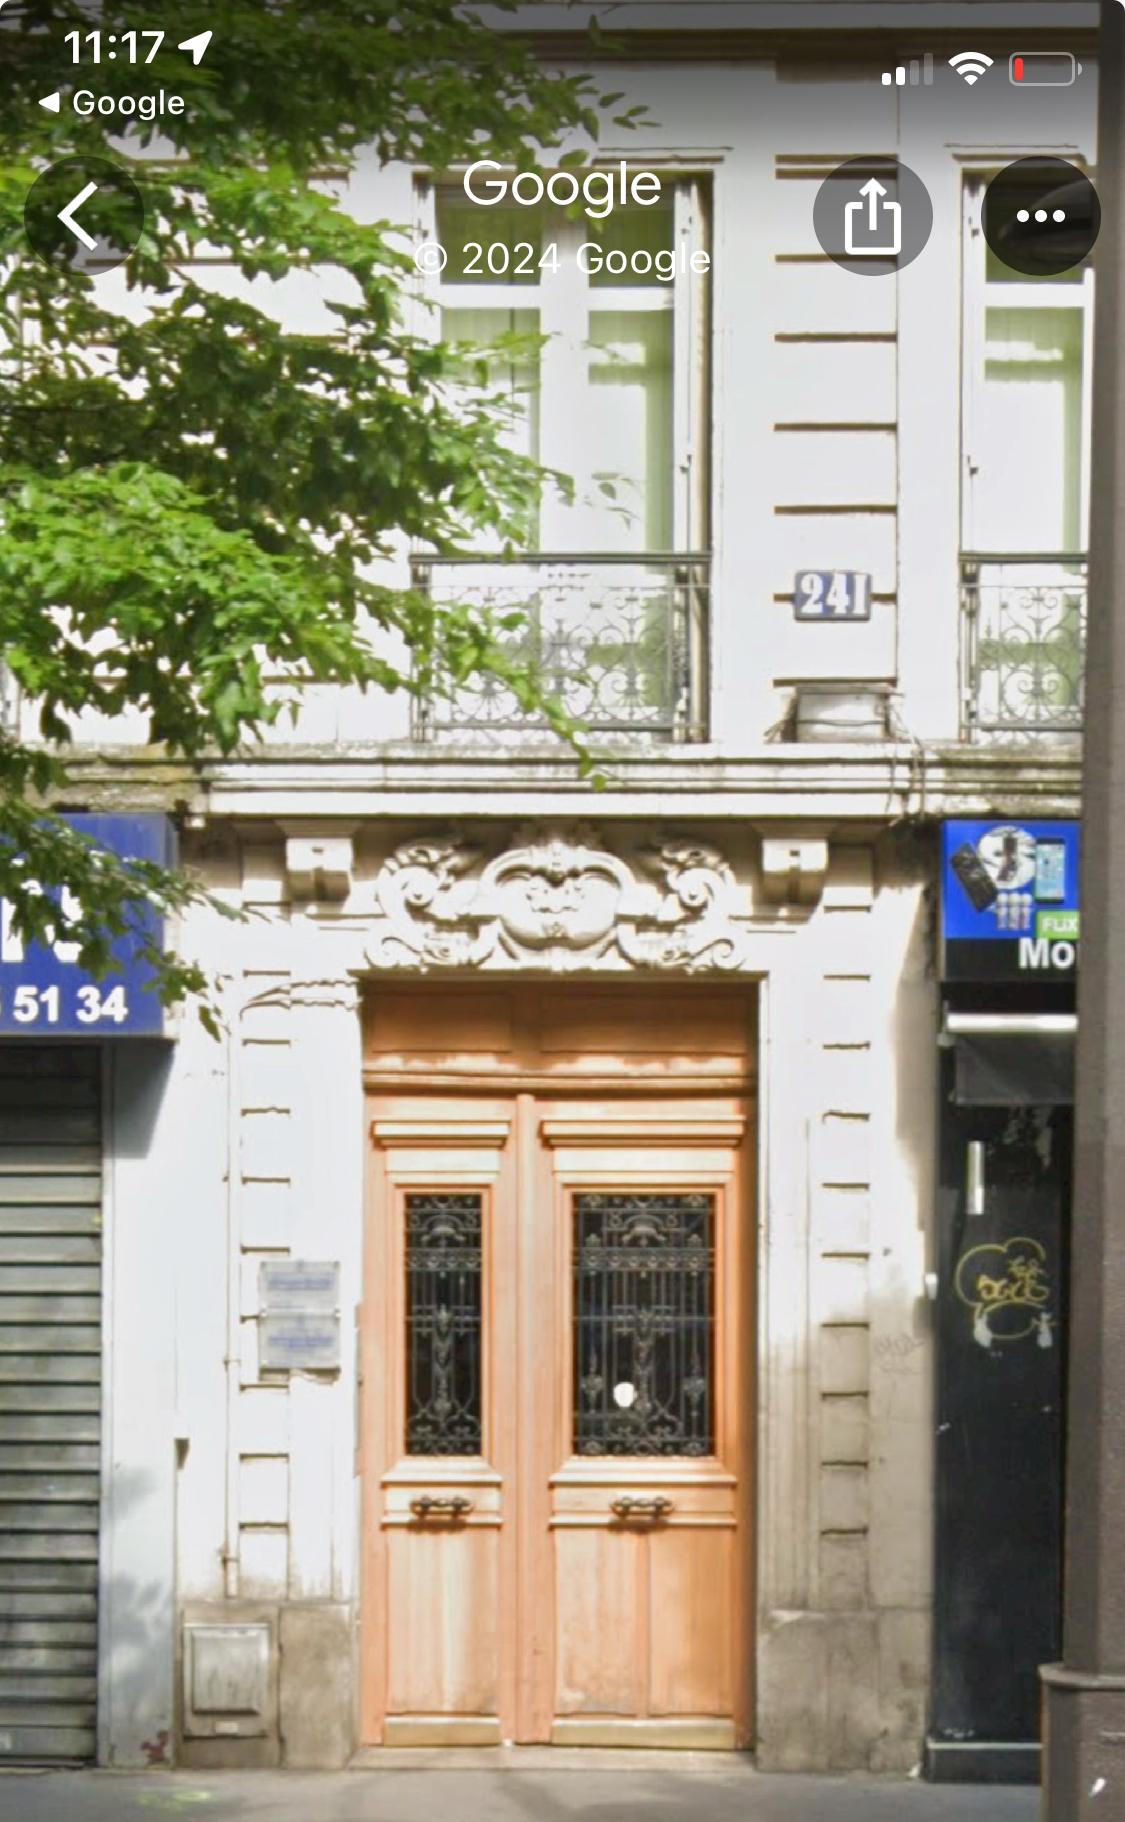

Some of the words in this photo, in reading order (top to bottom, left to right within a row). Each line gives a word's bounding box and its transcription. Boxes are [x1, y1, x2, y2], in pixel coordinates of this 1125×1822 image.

[801, 572, 868, 615] 241
[1019, 937, 1076, 969] Mo
[13, 985, 60, 1023] 51
[76, 985, 129, 1023] 34
